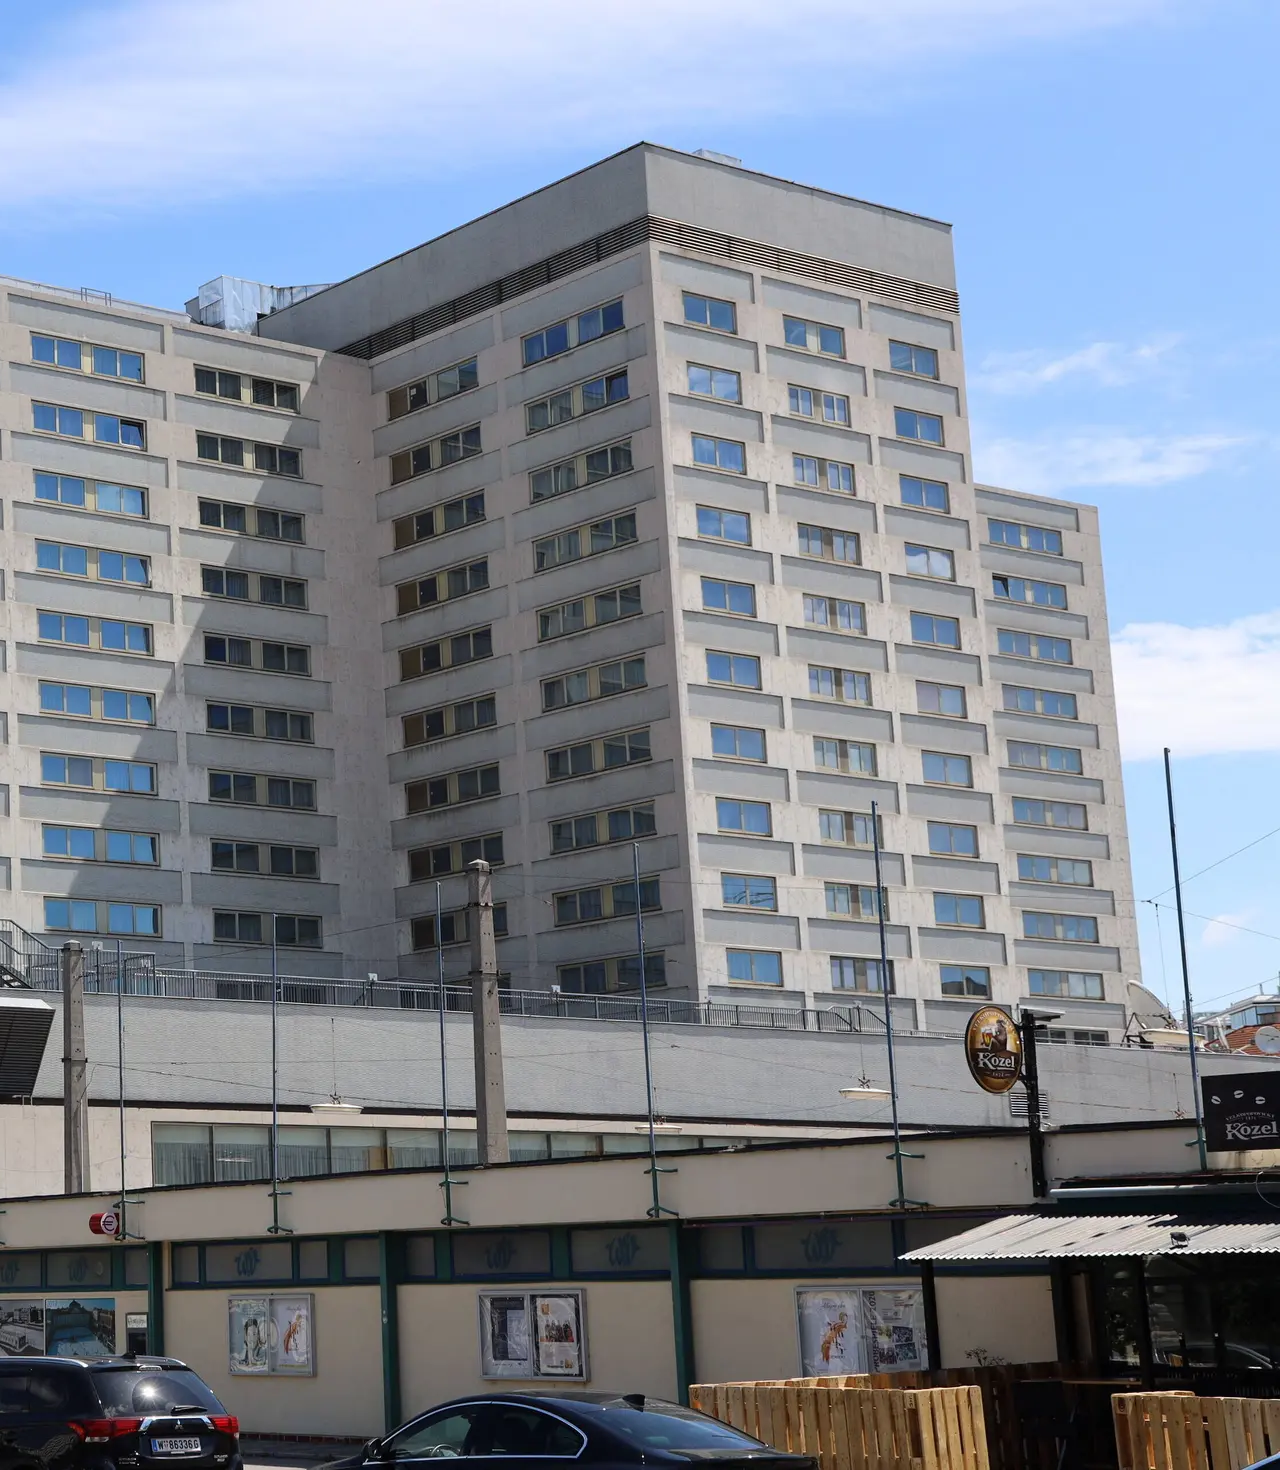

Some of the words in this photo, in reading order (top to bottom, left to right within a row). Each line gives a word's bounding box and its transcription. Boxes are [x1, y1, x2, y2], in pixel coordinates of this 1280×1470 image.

[977, 1052, 1015, 1071] Kozel
[1225, 1121, 1279, 1140] Kozel
[157, 1440, 164, 1450] W
